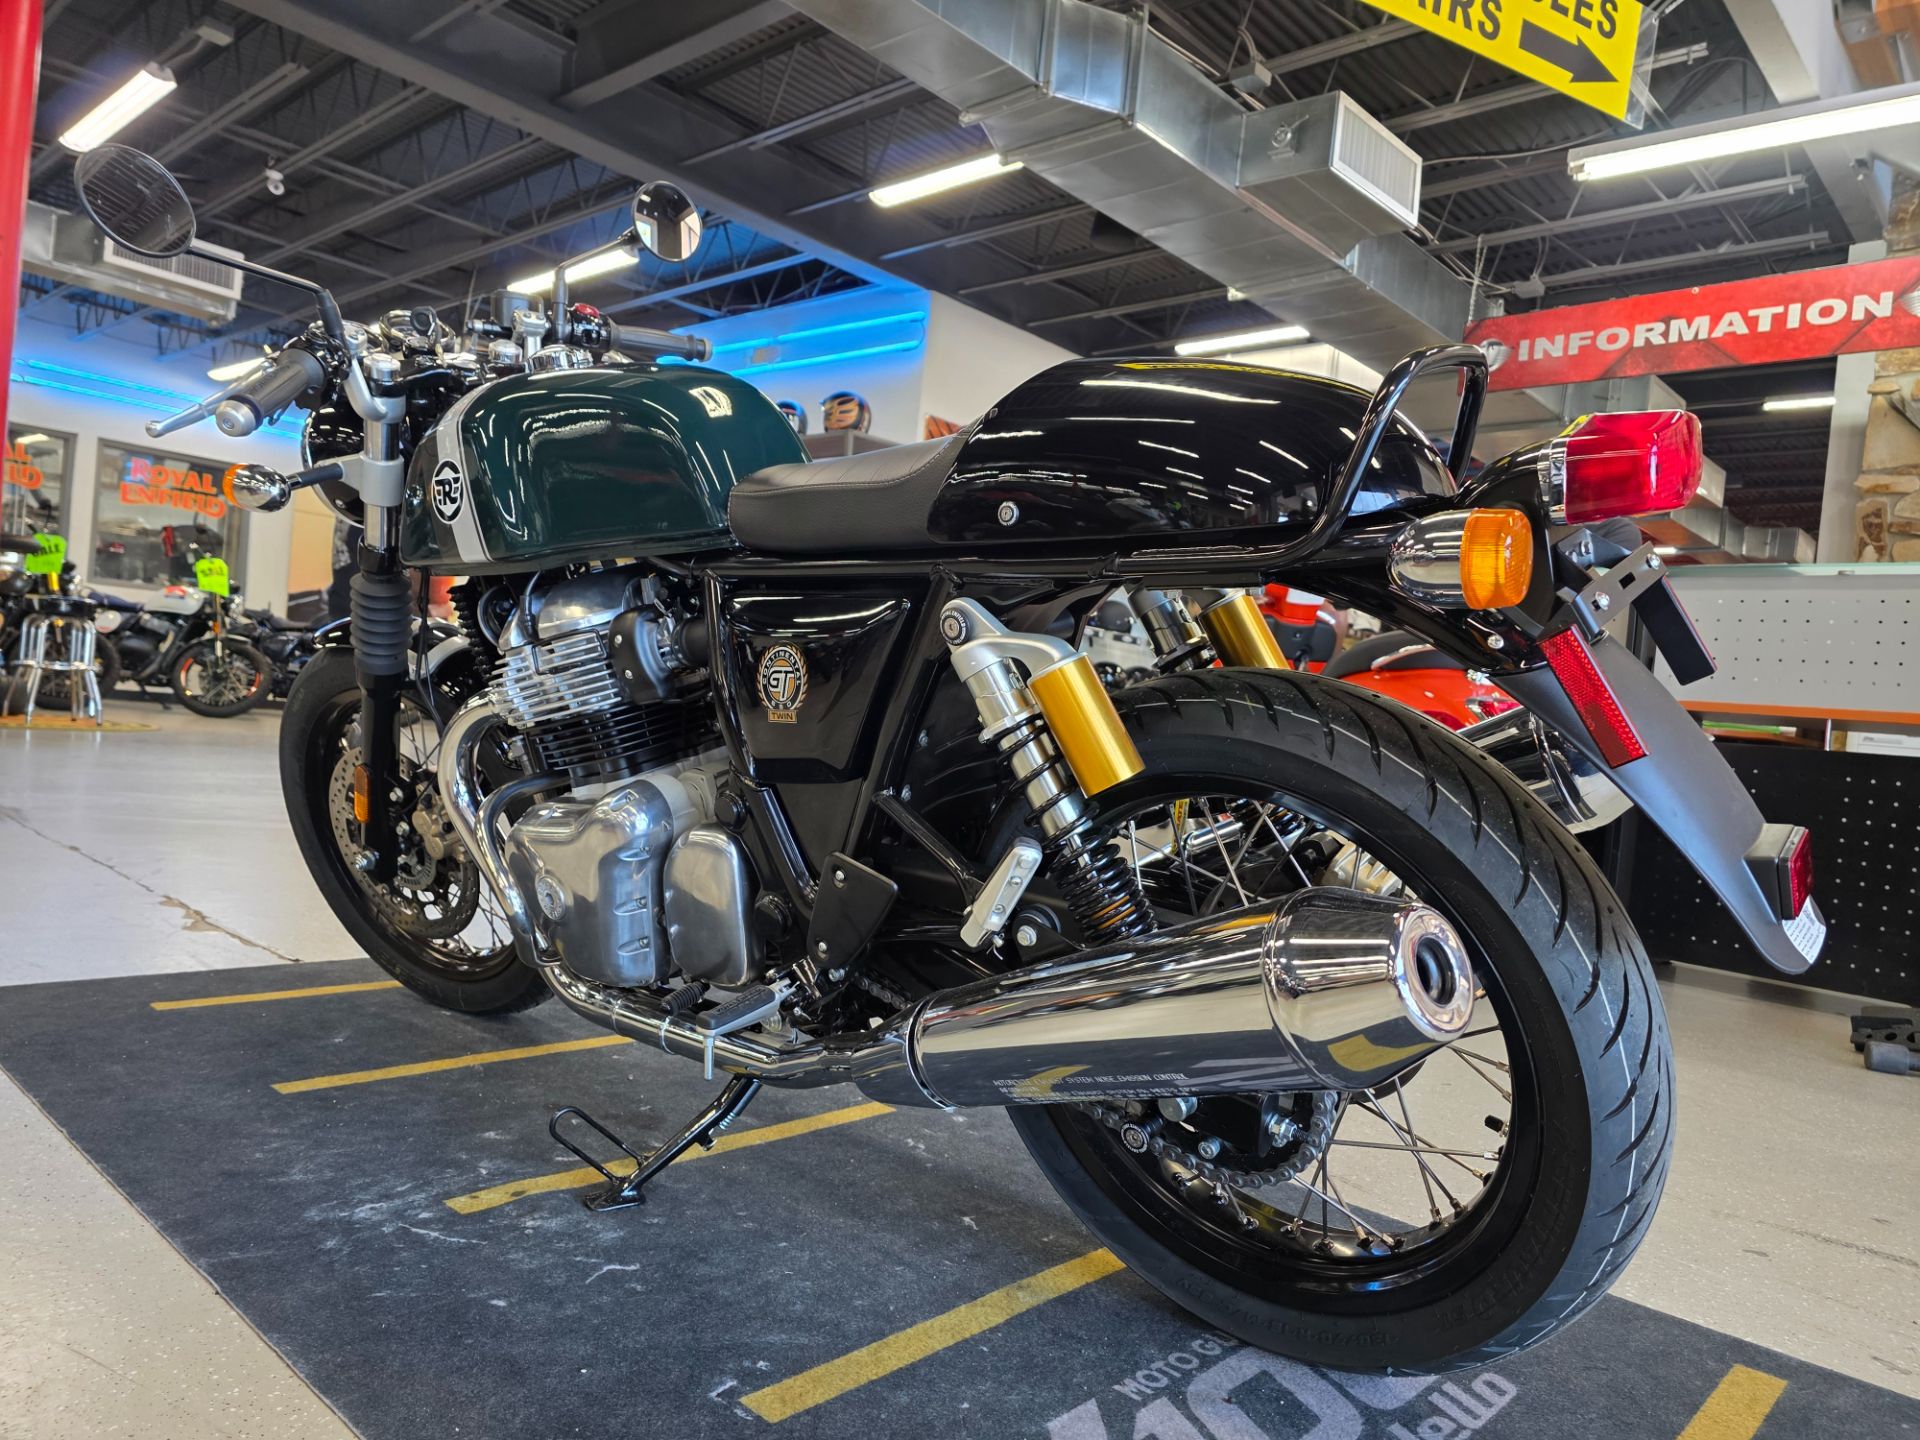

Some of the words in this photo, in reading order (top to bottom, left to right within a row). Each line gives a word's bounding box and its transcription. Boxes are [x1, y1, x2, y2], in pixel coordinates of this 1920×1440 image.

[1517, 290, 1894, 362] INFORMATION
[129, 456, 218, 494] ROYAL
[120, 481, 227, 520] ENFIELD
[762, 650, 801, 686] CONTINENTAL
[768, 666, 796, 701] GT
[770, 711, 794, 721] TWIN
[1152, 1072, 1190, 1082] CONTROL
[1112, 1351, 1200, 1401] MOTO
